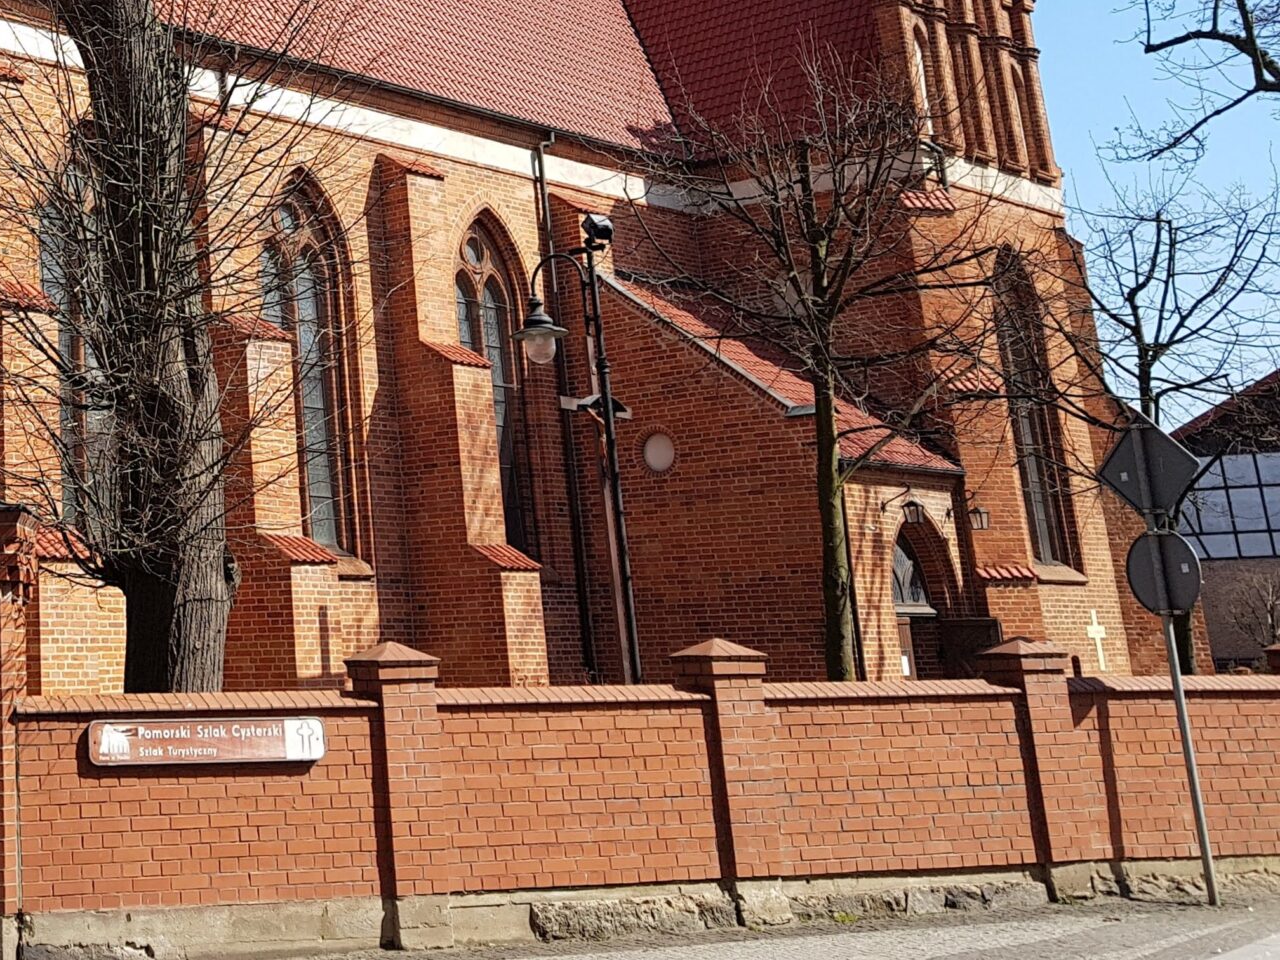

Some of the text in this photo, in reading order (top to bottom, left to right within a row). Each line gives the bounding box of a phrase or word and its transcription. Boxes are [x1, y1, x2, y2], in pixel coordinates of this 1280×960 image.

[138, 723, 282, 740] Pomorski Szlak Cysterski
[139, 745, 218, 758] Szlak Turystyczny
